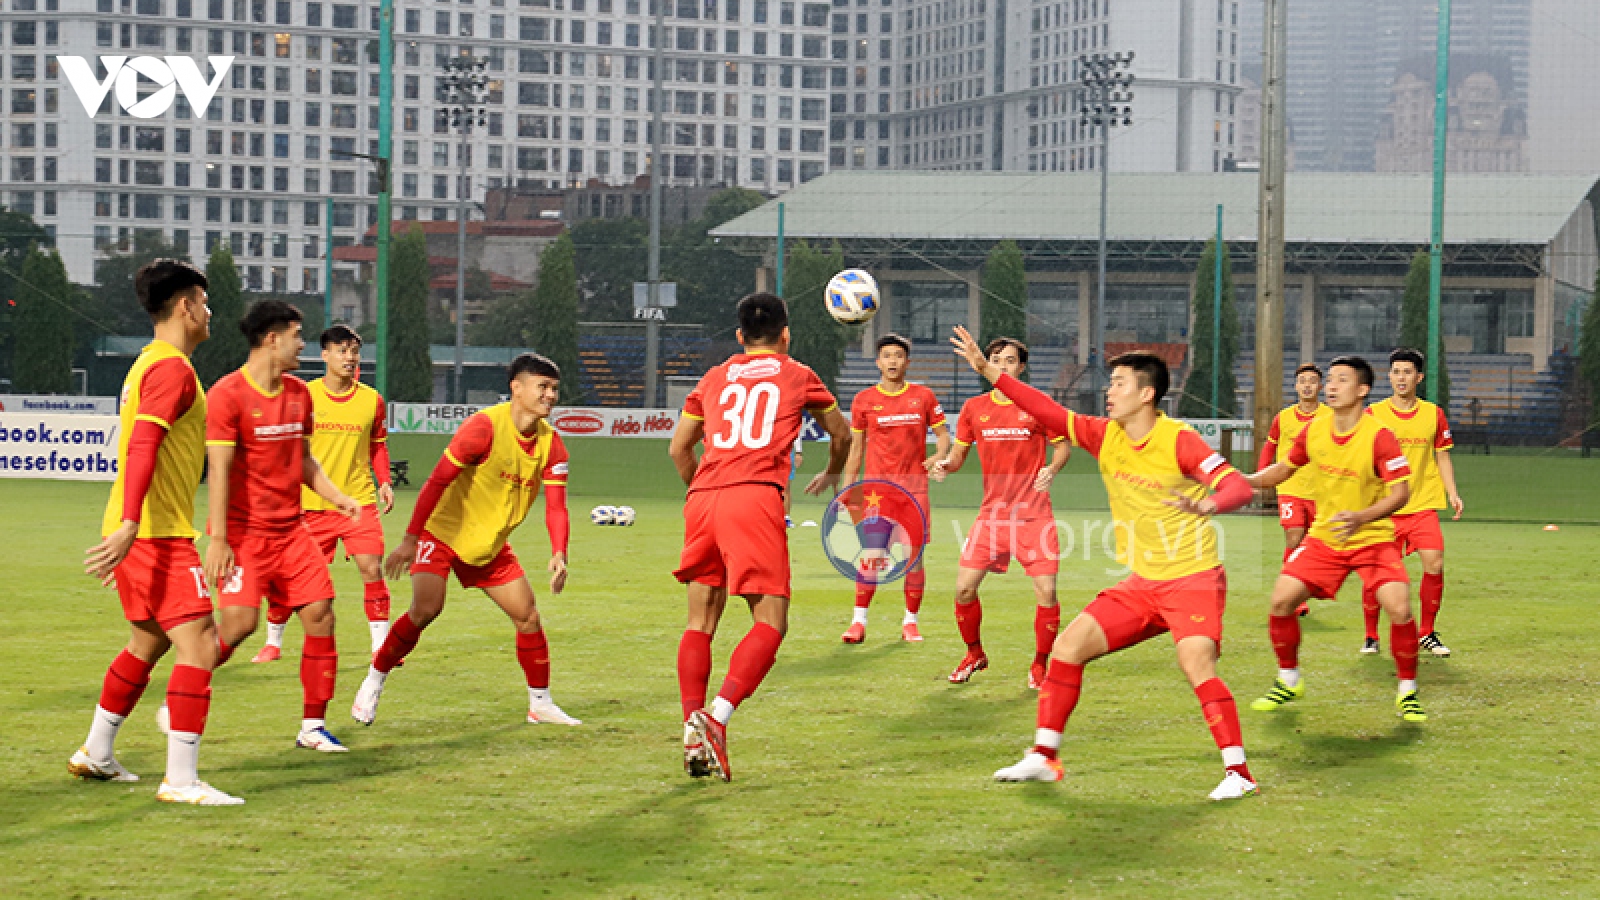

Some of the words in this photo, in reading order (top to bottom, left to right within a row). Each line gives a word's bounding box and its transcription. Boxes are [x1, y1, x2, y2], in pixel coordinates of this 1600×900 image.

[634, 307, 666, 320] FIFA
[714, 382, 780, 449] 30
[415, 540, 436, 565] 12
